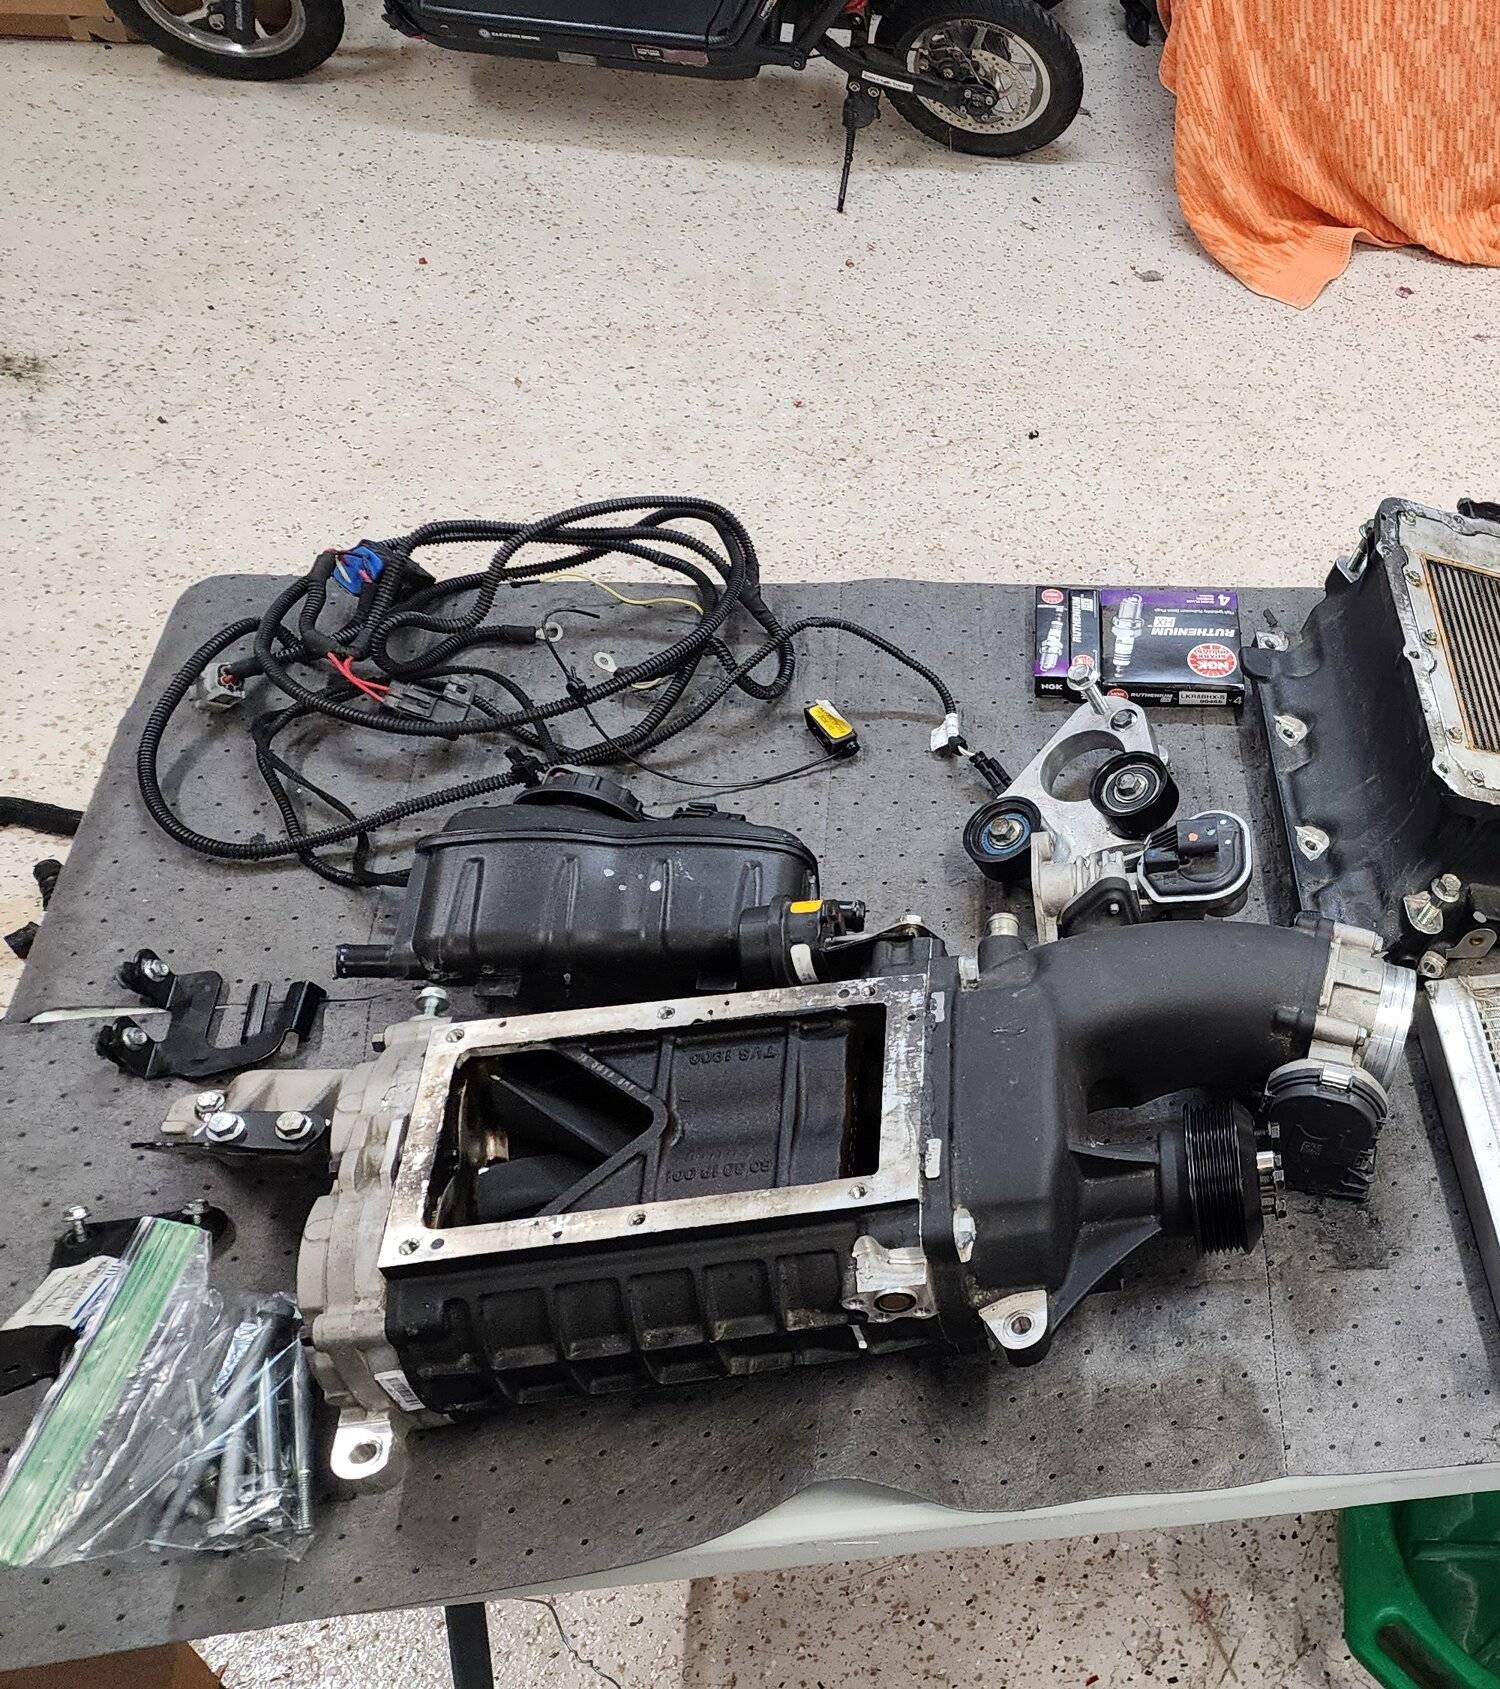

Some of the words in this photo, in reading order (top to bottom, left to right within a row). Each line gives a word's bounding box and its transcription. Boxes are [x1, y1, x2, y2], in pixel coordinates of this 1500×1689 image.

[1218, 594, 1231, 606] 4
[1072, 596, 1082, 643] RUTHENIUM
[1151, 627, 1235, 637] RUTHENIUM
[1197, 660, 1229, 669] NGK
